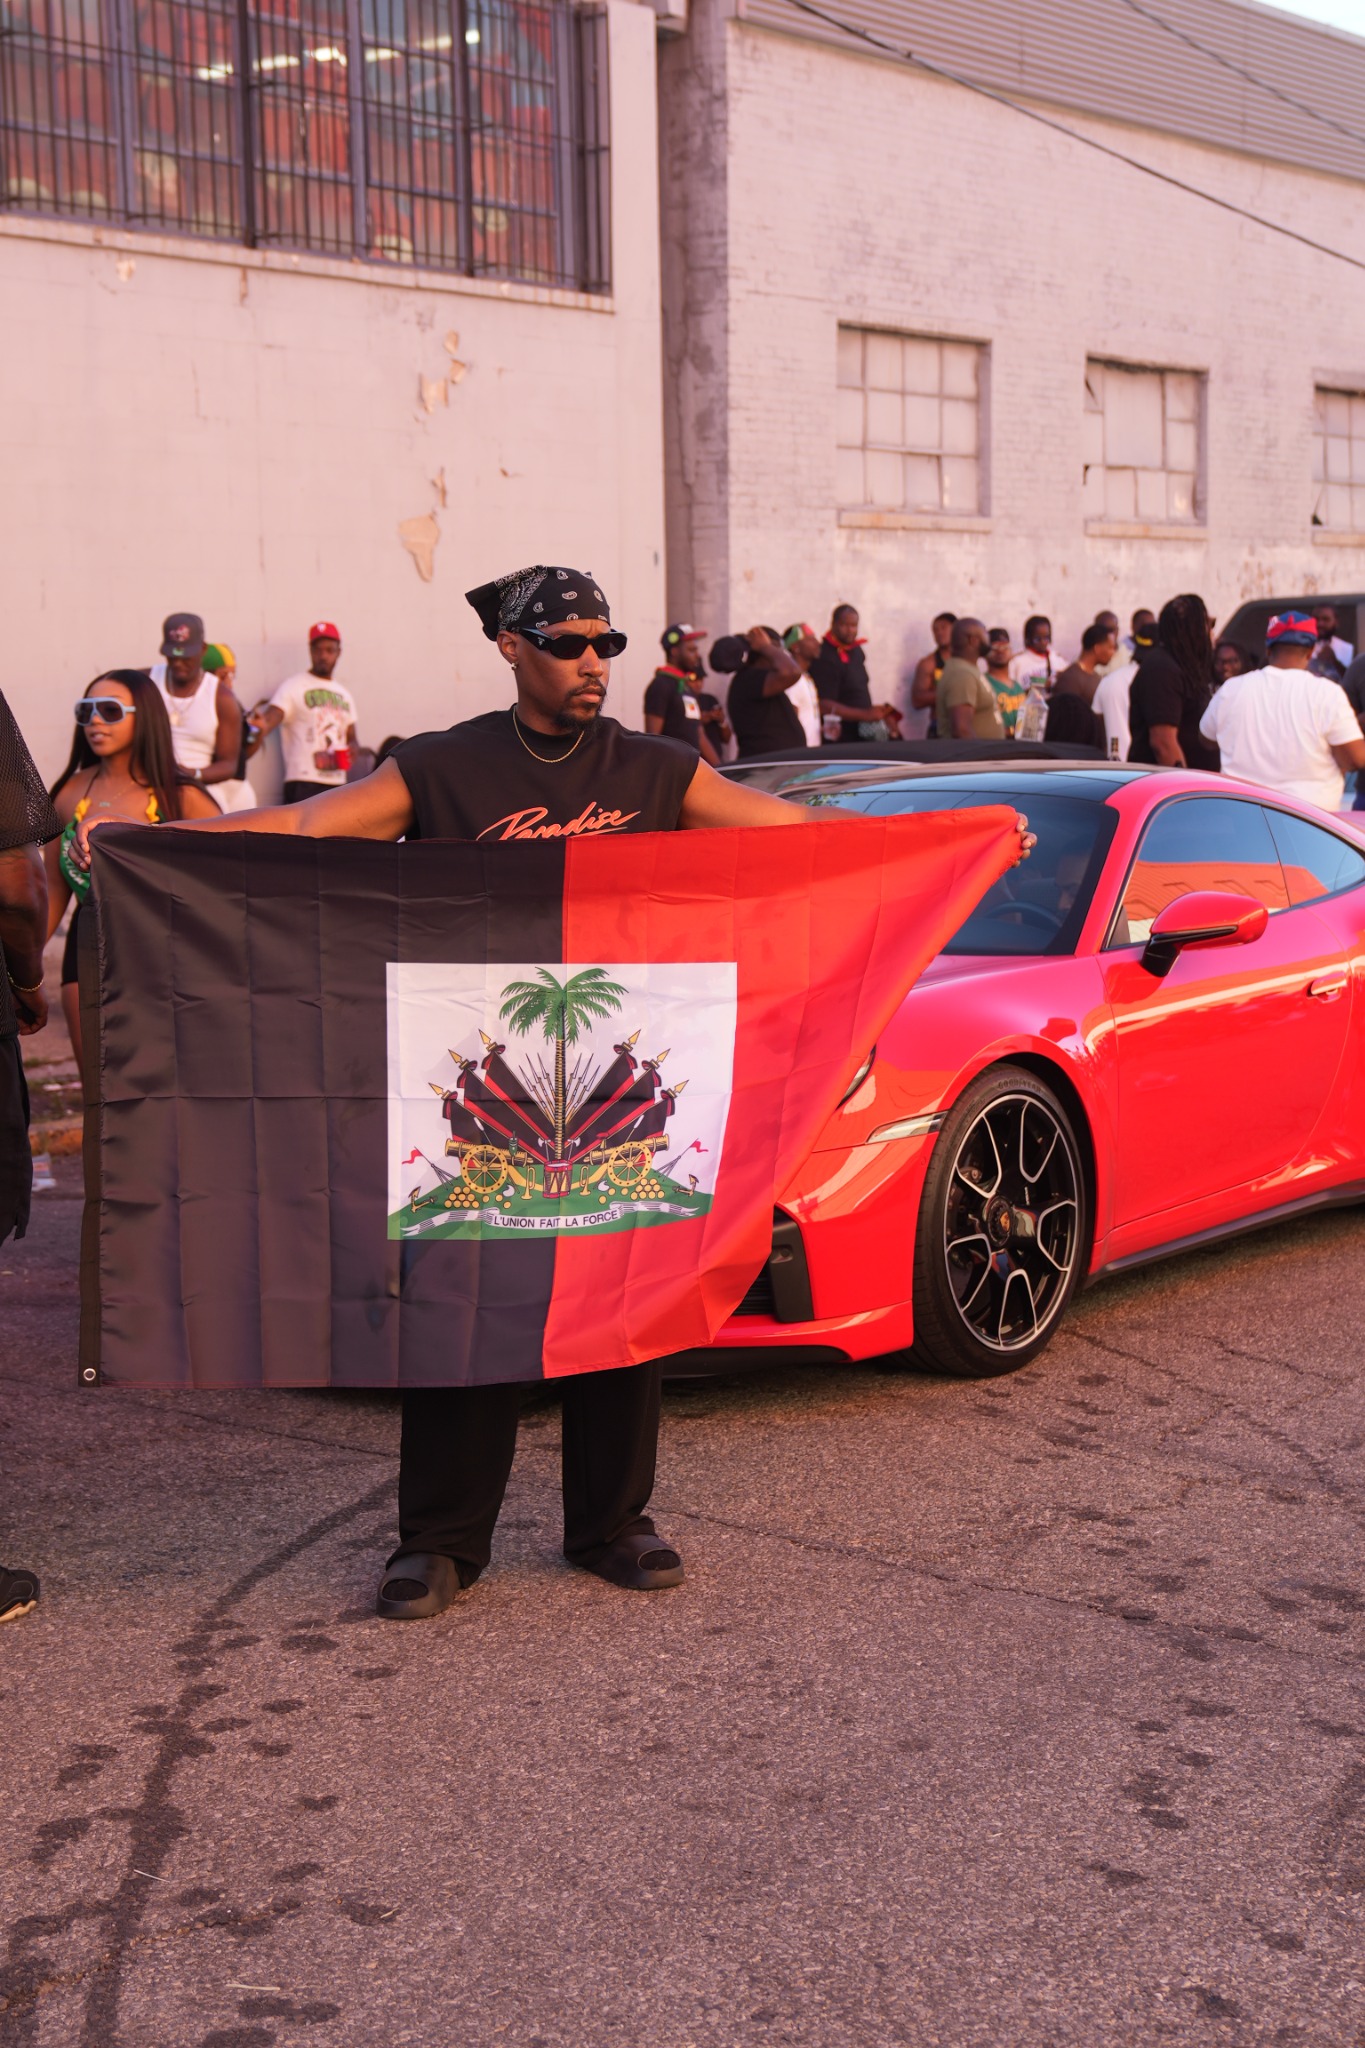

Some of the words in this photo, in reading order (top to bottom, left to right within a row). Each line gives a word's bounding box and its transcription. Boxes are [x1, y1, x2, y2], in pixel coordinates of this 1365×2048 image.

[476, 801, 641, 840] Paradise
[494, 1216, 535, 1228] L'UNION
[539, 1218, 561, 1228] FAIT
[565, 1216, 578, 1227] LA
[583, 1210, 618, 1226] FORCE
